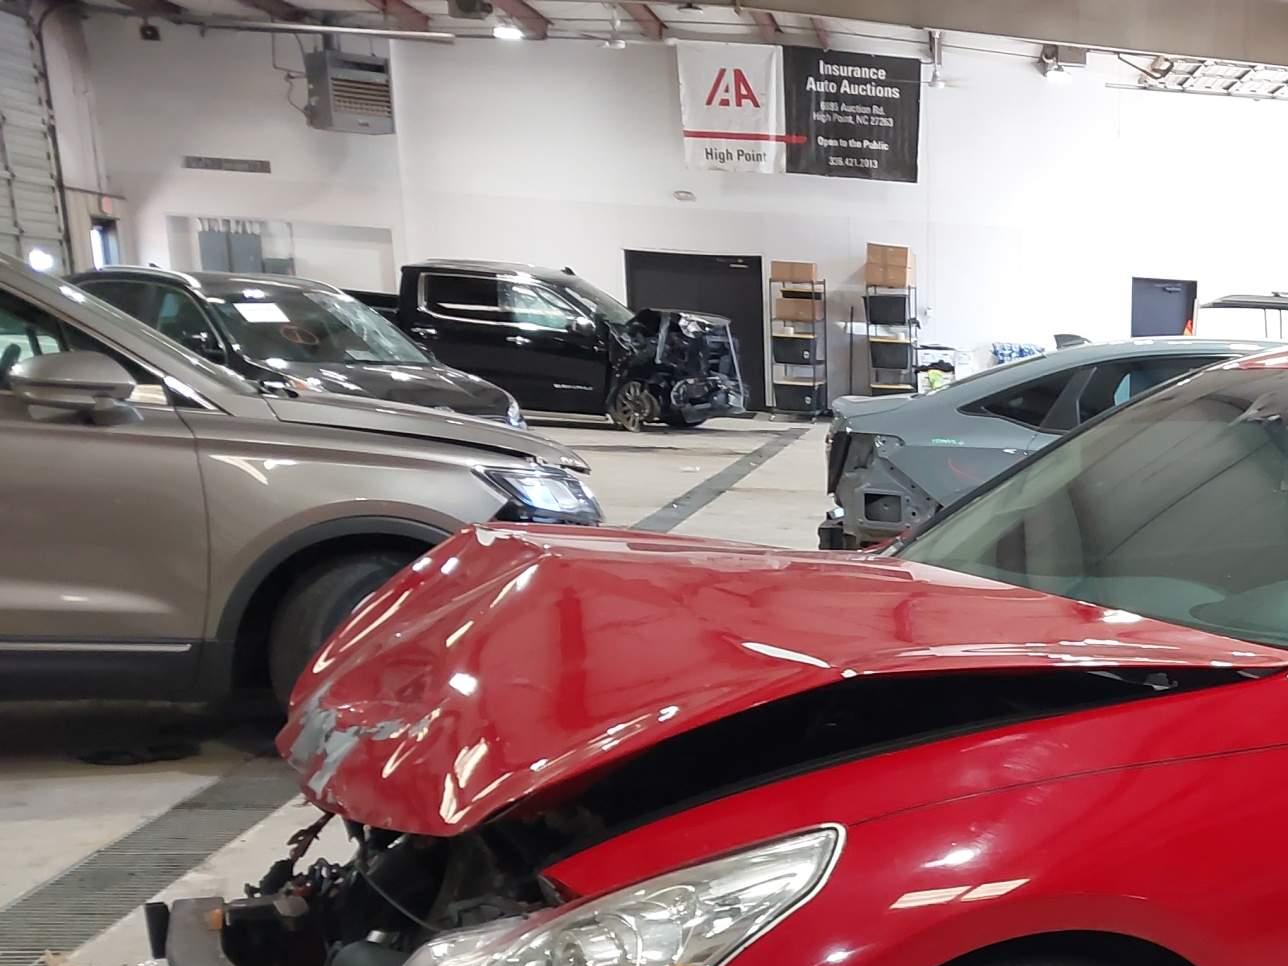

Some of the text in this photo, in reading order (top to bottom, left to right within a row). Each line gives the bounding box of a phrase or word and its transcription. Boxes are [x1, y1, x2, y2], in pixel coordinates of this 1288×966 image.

[819, 60, 886, 80] Insurance
[806, 77, 900, 98] Auto Auctions
[841, 103, 872, 114] Auction
[872, 105, 886, 115] Rd.
[813, 111, 831, 124] High
[856, 114, 870, 125] NC
[817, 136, 889, 150] Open to the Public
[705, 148, 767, 164] High Point
